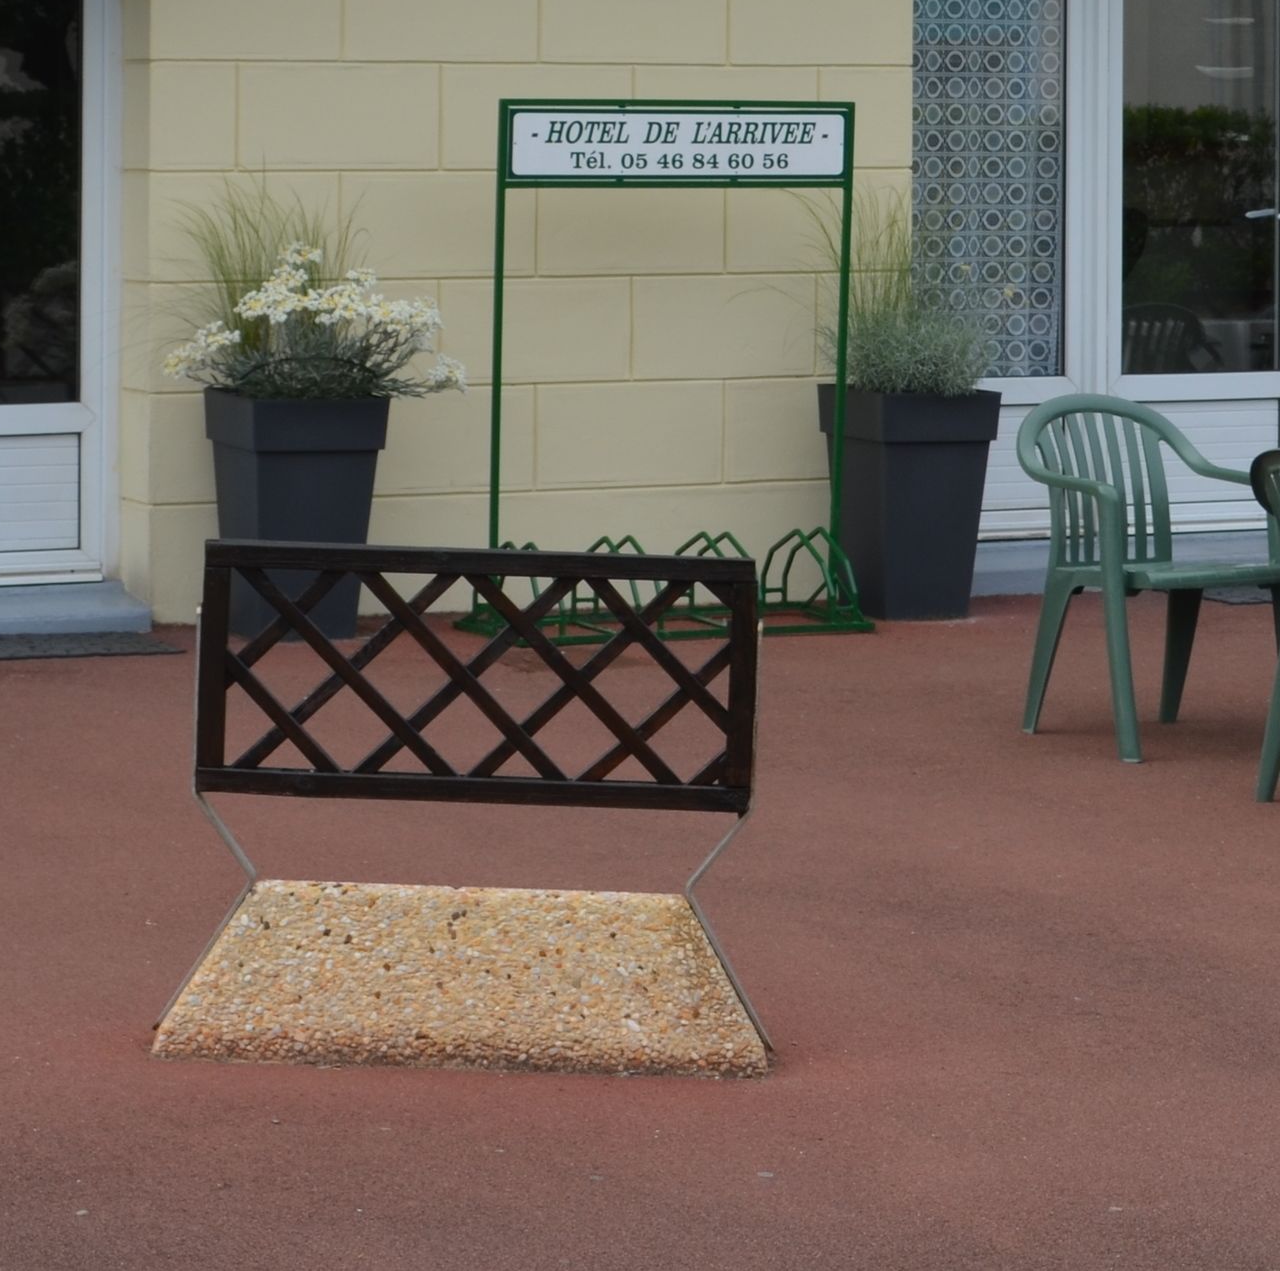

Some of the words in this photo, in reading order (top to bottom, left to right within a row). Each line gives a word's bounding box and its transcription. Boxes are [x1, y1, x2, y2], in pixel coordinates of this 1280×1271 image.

[544, 121, 630, 144] HOTEL
[643, 121, 679, 144] DE
[691, 121, 816, 145] L'ARRIVEE
[570, 151, 611, 170] Tél.
[621, 153, 648, 170] 05
[657, 153, 684, 170] 46
[692, 153, 719, 170] 84
[728, 153, 754, 170] 60
[762, 153, 789, 170] 56
